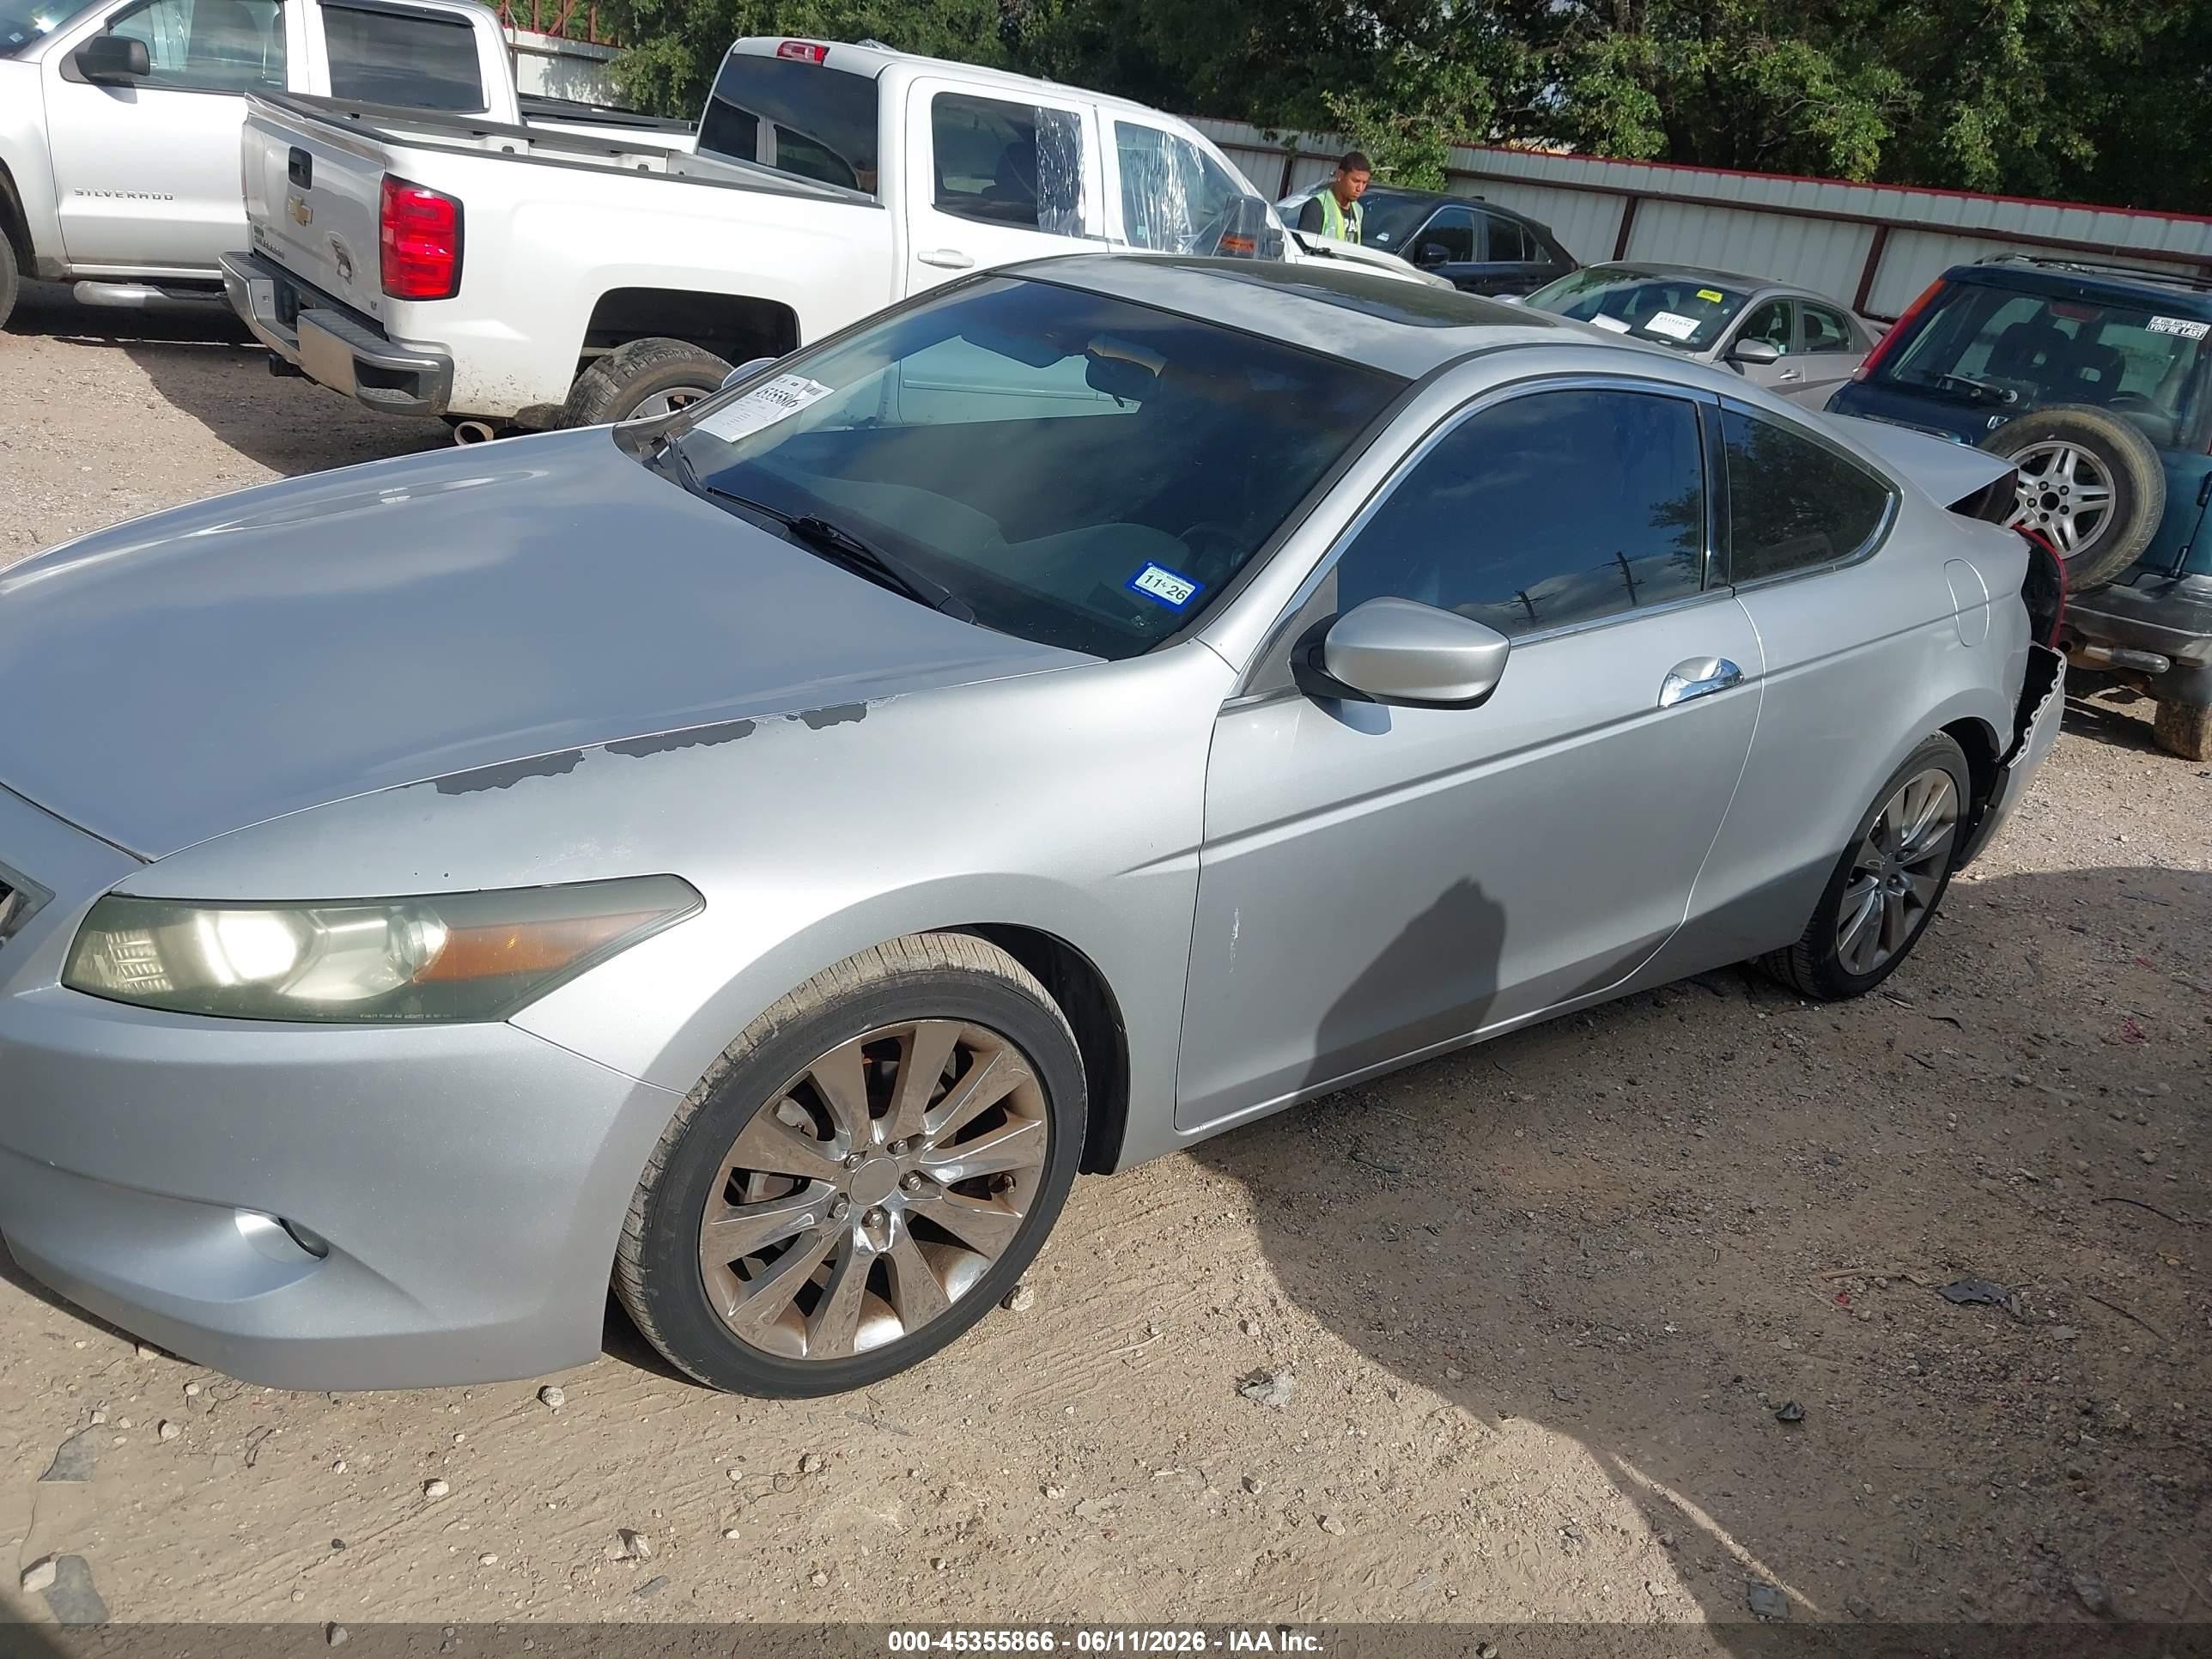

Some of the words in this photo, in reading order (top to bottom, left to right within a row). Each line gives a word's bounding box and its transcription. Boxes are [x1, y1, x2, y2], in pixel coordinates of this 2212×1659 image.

[74, 187, 173, 201] SILVERADO
[2149, 323, 2180, 334] YOU'RE
[2181, 328, 2204, 338] LAST
